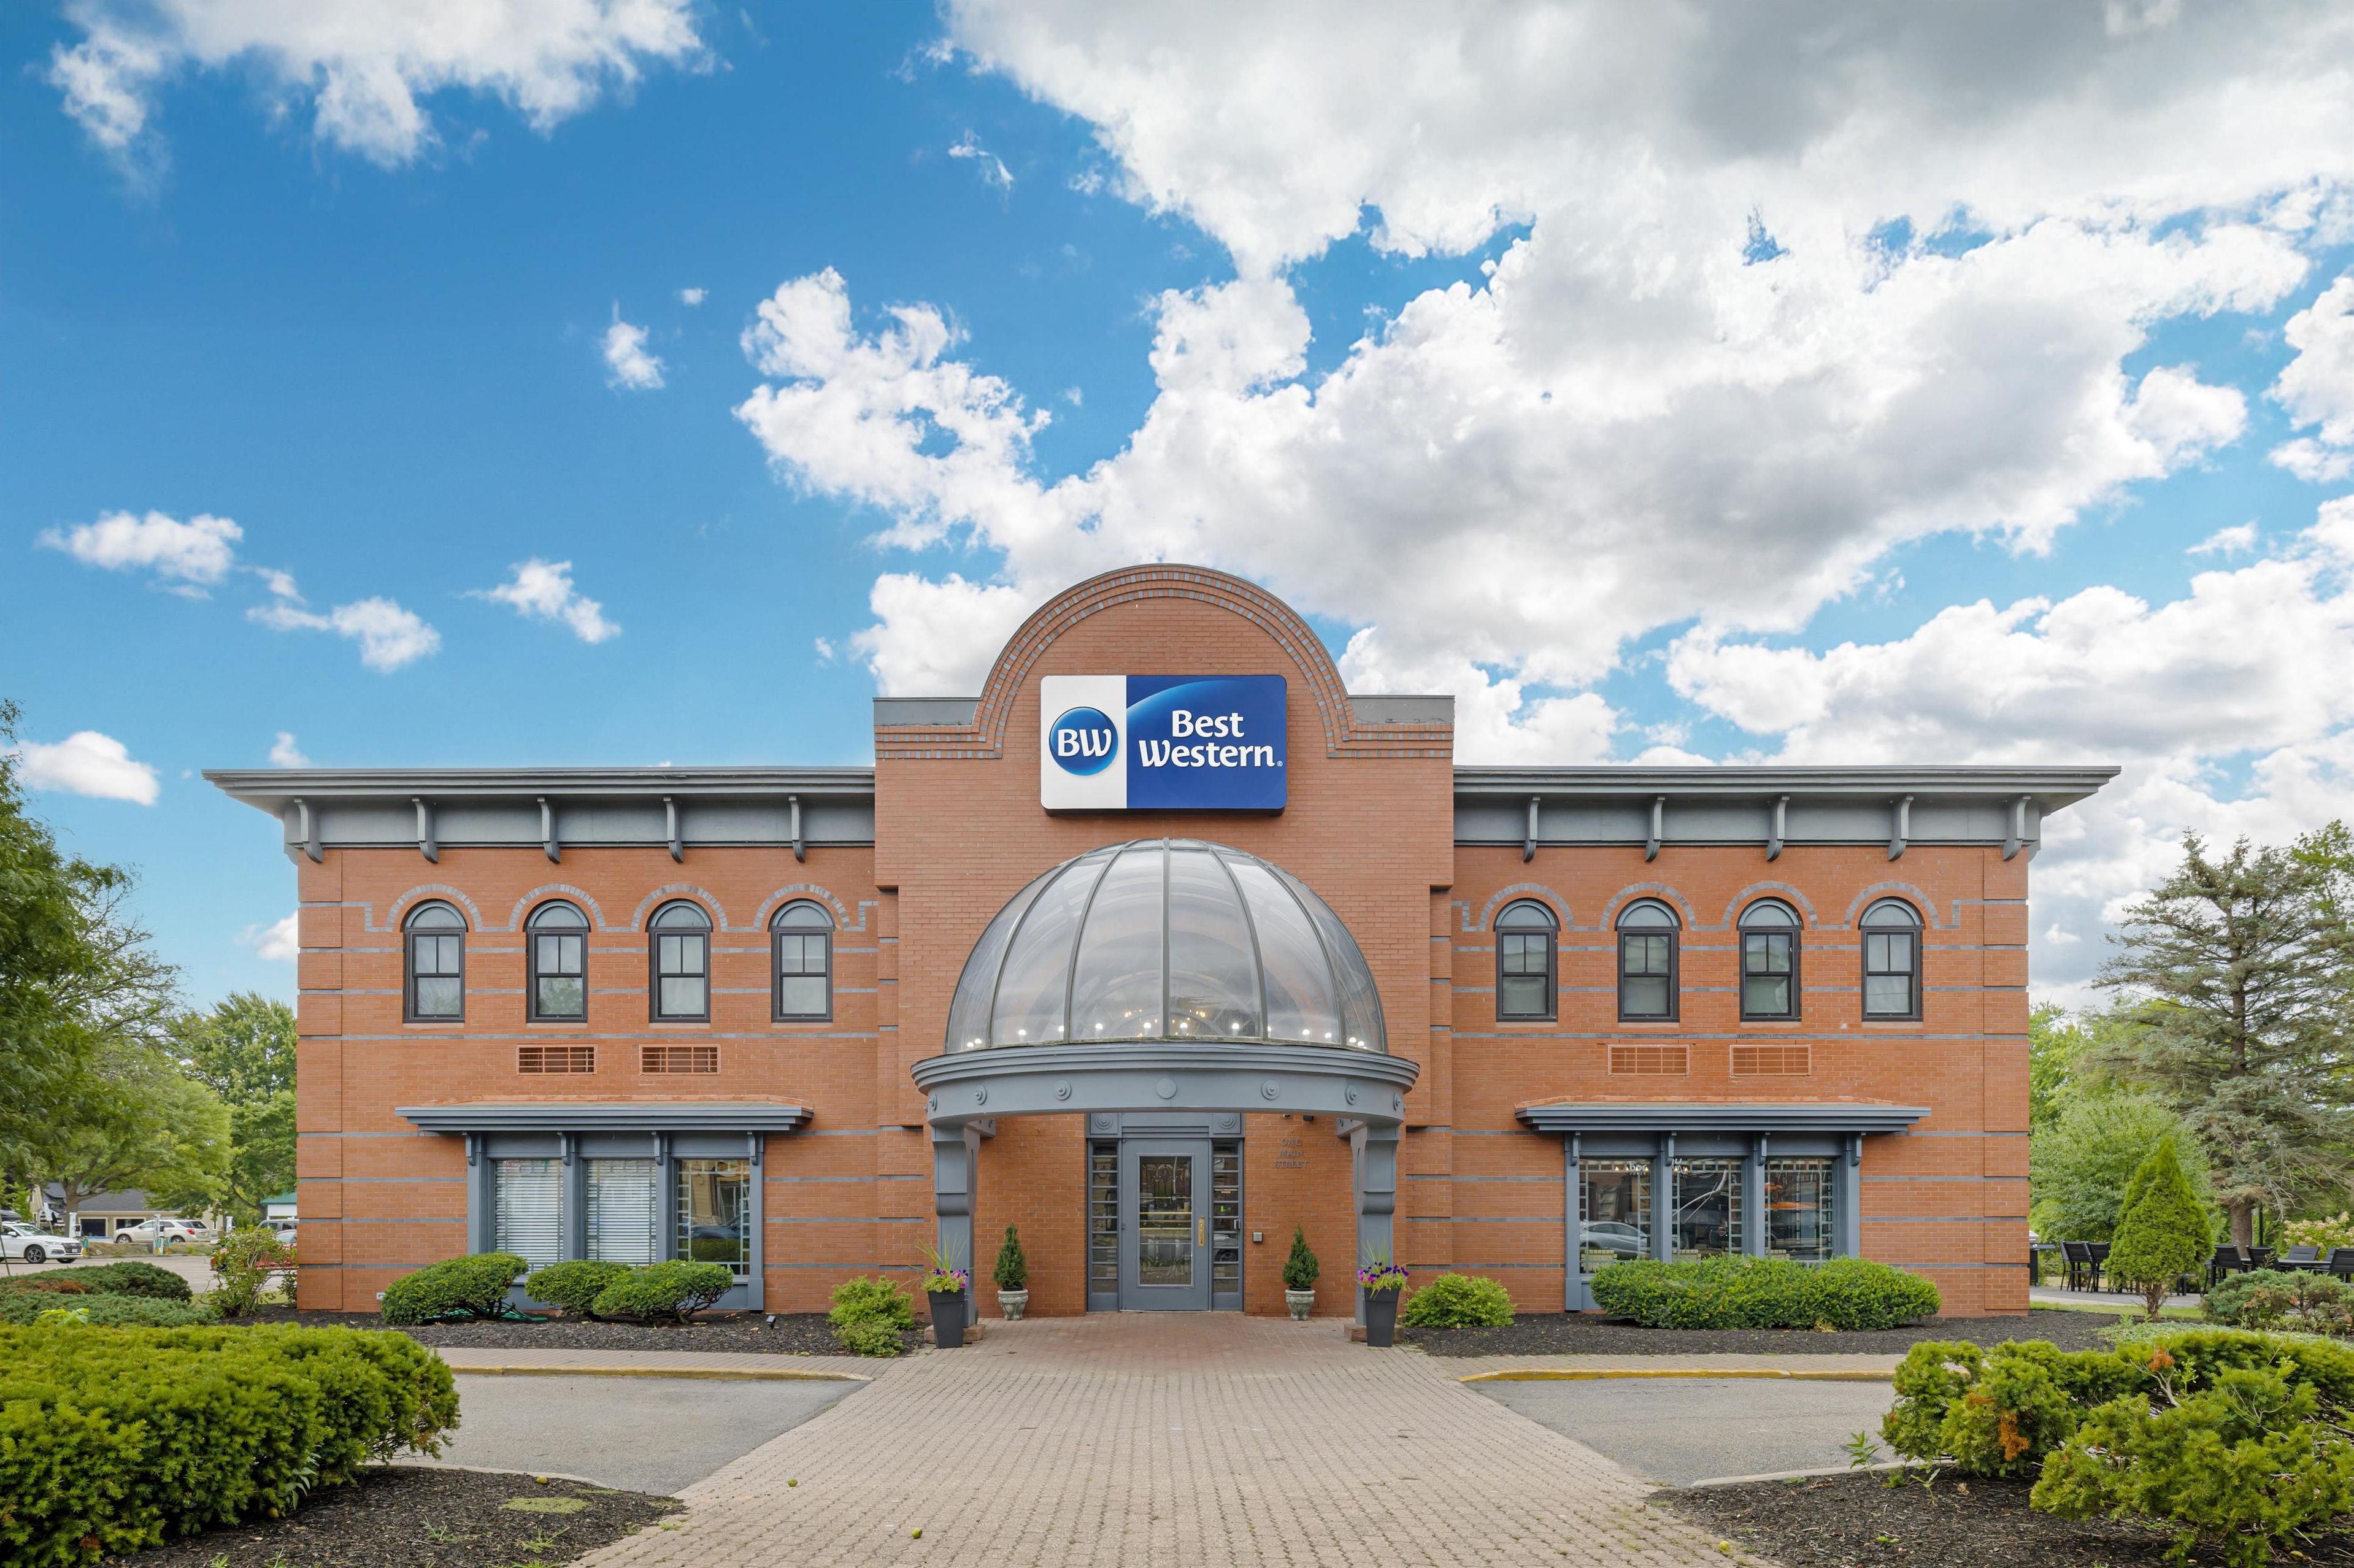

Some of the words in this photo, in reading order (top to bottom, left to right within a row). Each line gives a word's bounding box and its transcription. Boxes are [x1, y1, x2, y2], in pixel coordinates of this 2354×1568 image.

[1172, 710, 1245, 738] Best
[1058, 728, 1112, 757] BW
[1279, 1149, 1304, 1158] MAIN
[1274, 1160, 1309, 1169] STREET
